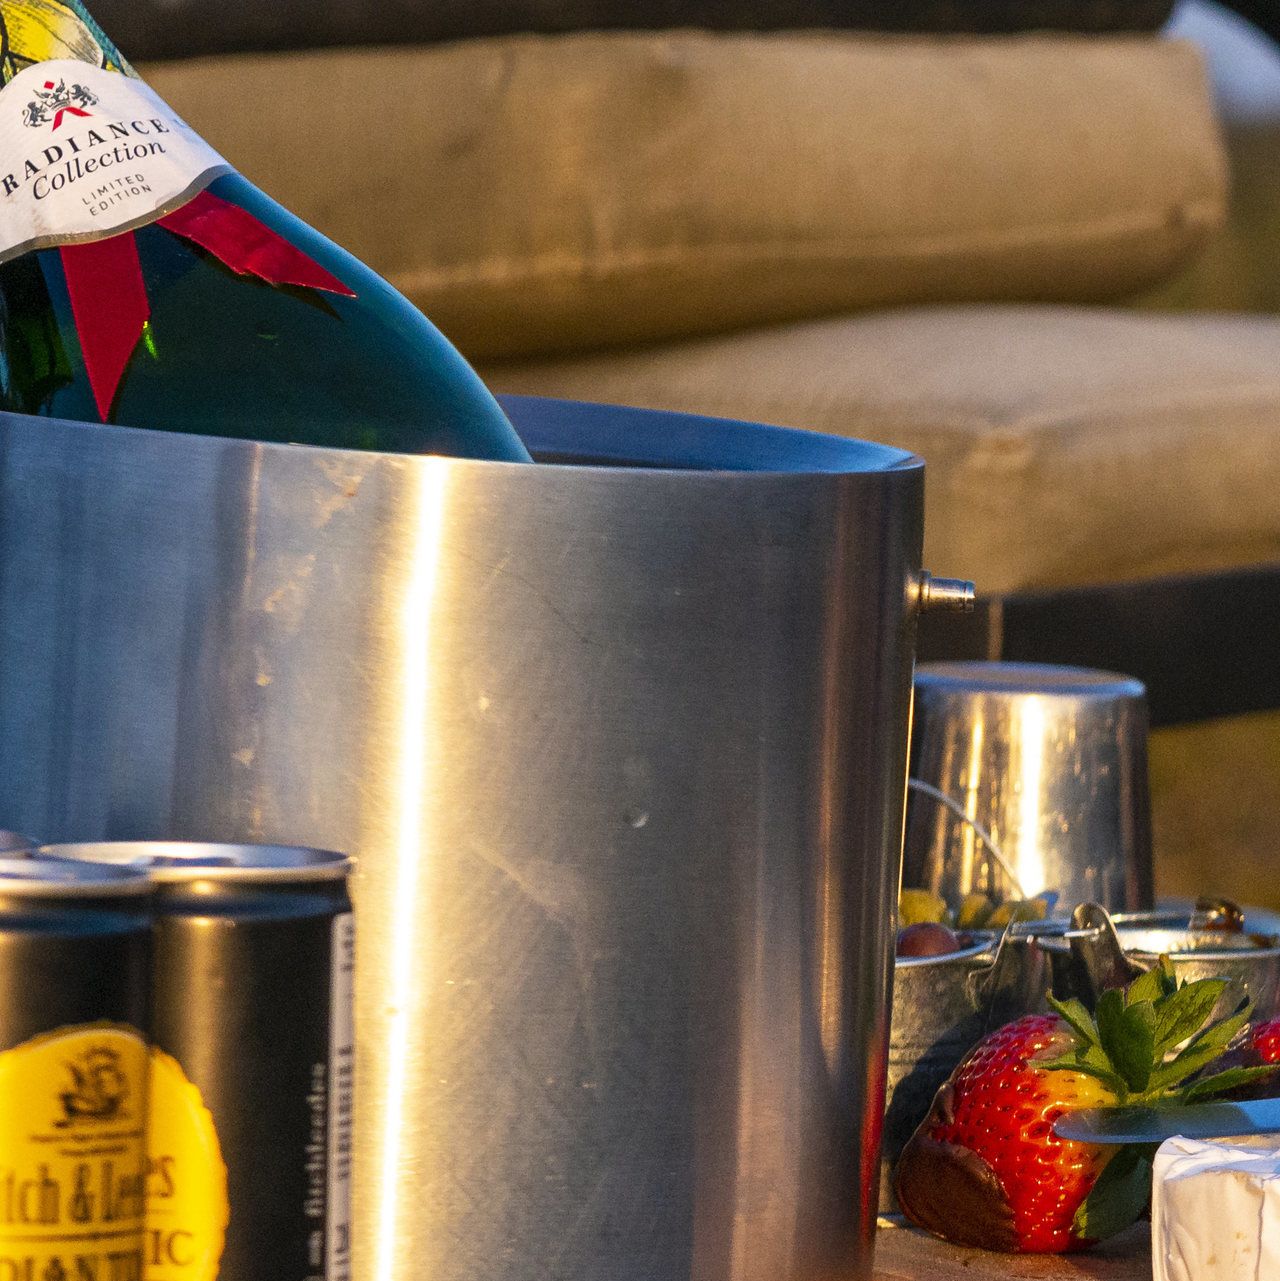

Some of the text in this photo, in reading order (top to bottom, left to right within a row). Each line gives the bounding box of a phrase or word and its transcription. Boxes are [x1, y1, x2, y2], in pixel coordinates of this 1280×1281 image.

[1, 118, 170, 197] RADIANCE
[32, 141, 166, 200] Collection
[82, 173, 145, 206] LIMITED
[89, 184, 153, 217] EDITION
[148, 1229, 193, 1266] IC
